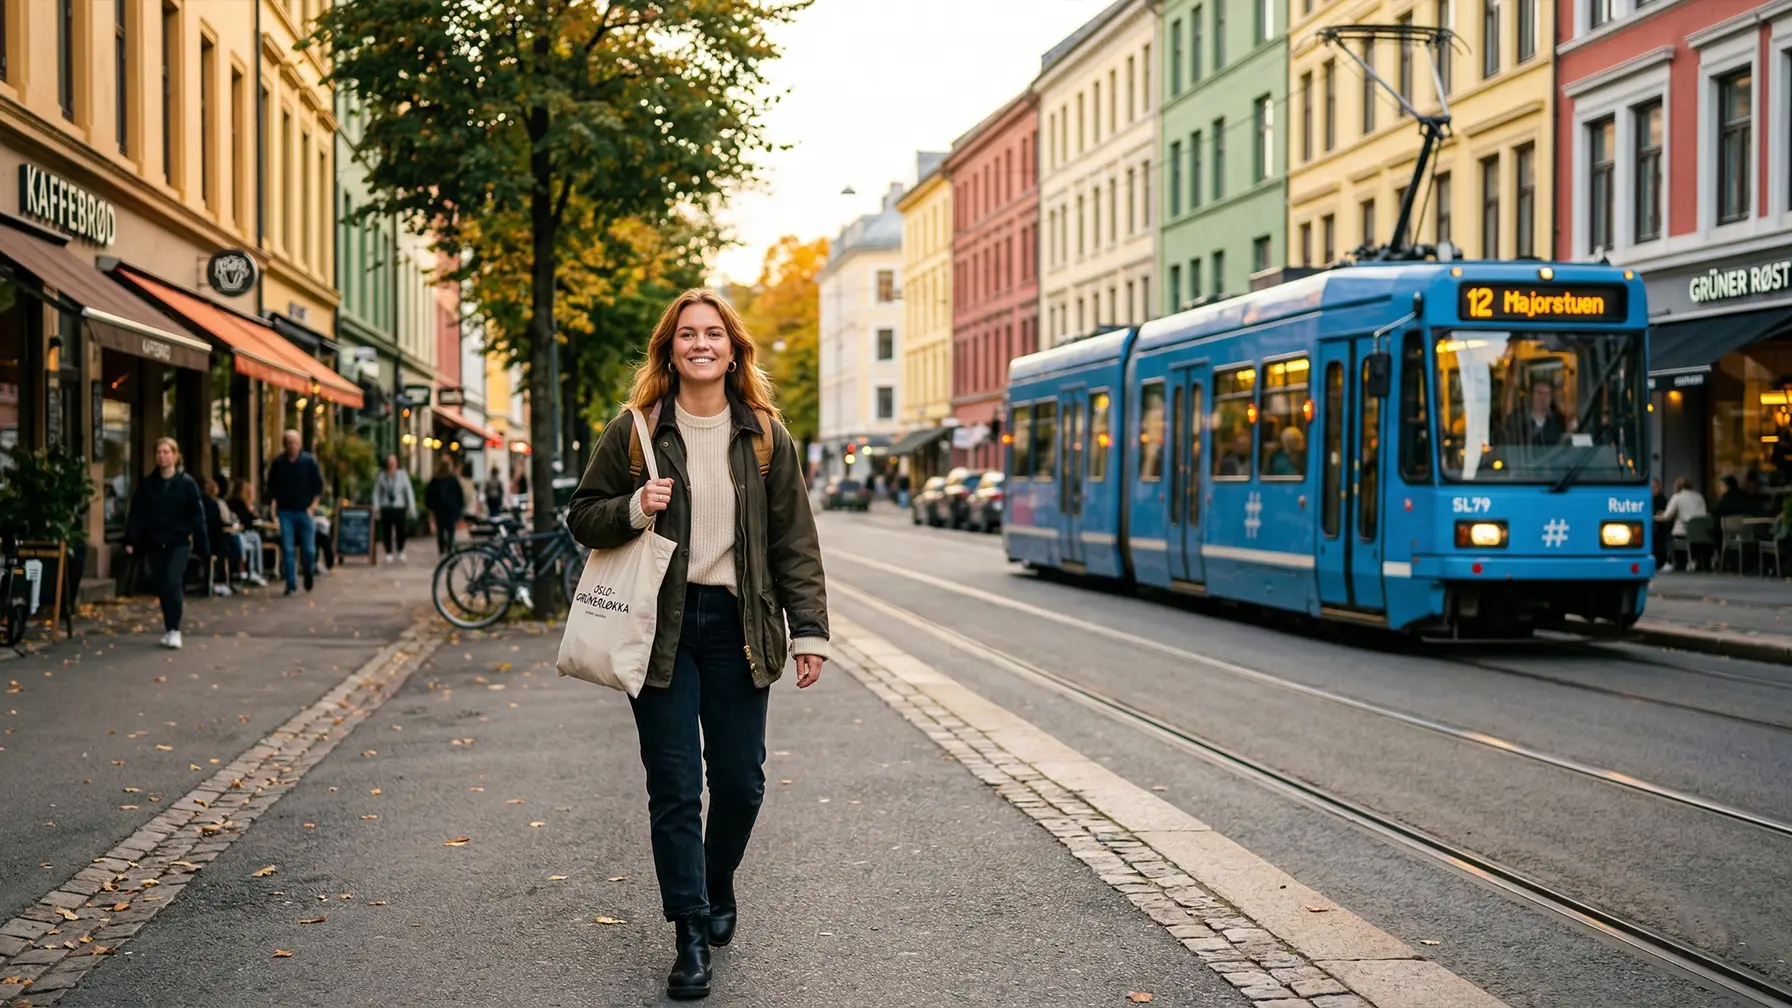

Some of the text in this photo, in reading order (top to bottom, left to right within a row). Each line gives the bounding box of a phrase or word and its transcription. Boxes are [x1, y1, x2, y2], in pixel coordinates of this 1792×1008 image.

[26, 163, 116, 246] KAFFEBRØD
[1688, 261, 1792, 302] GRÜNER RØST
[1466, 287, 1605, 317] 12 Majorstuen
[1452, 496, 1492, 513] SL79
[1608, 497, 1645, 513] Ruter
